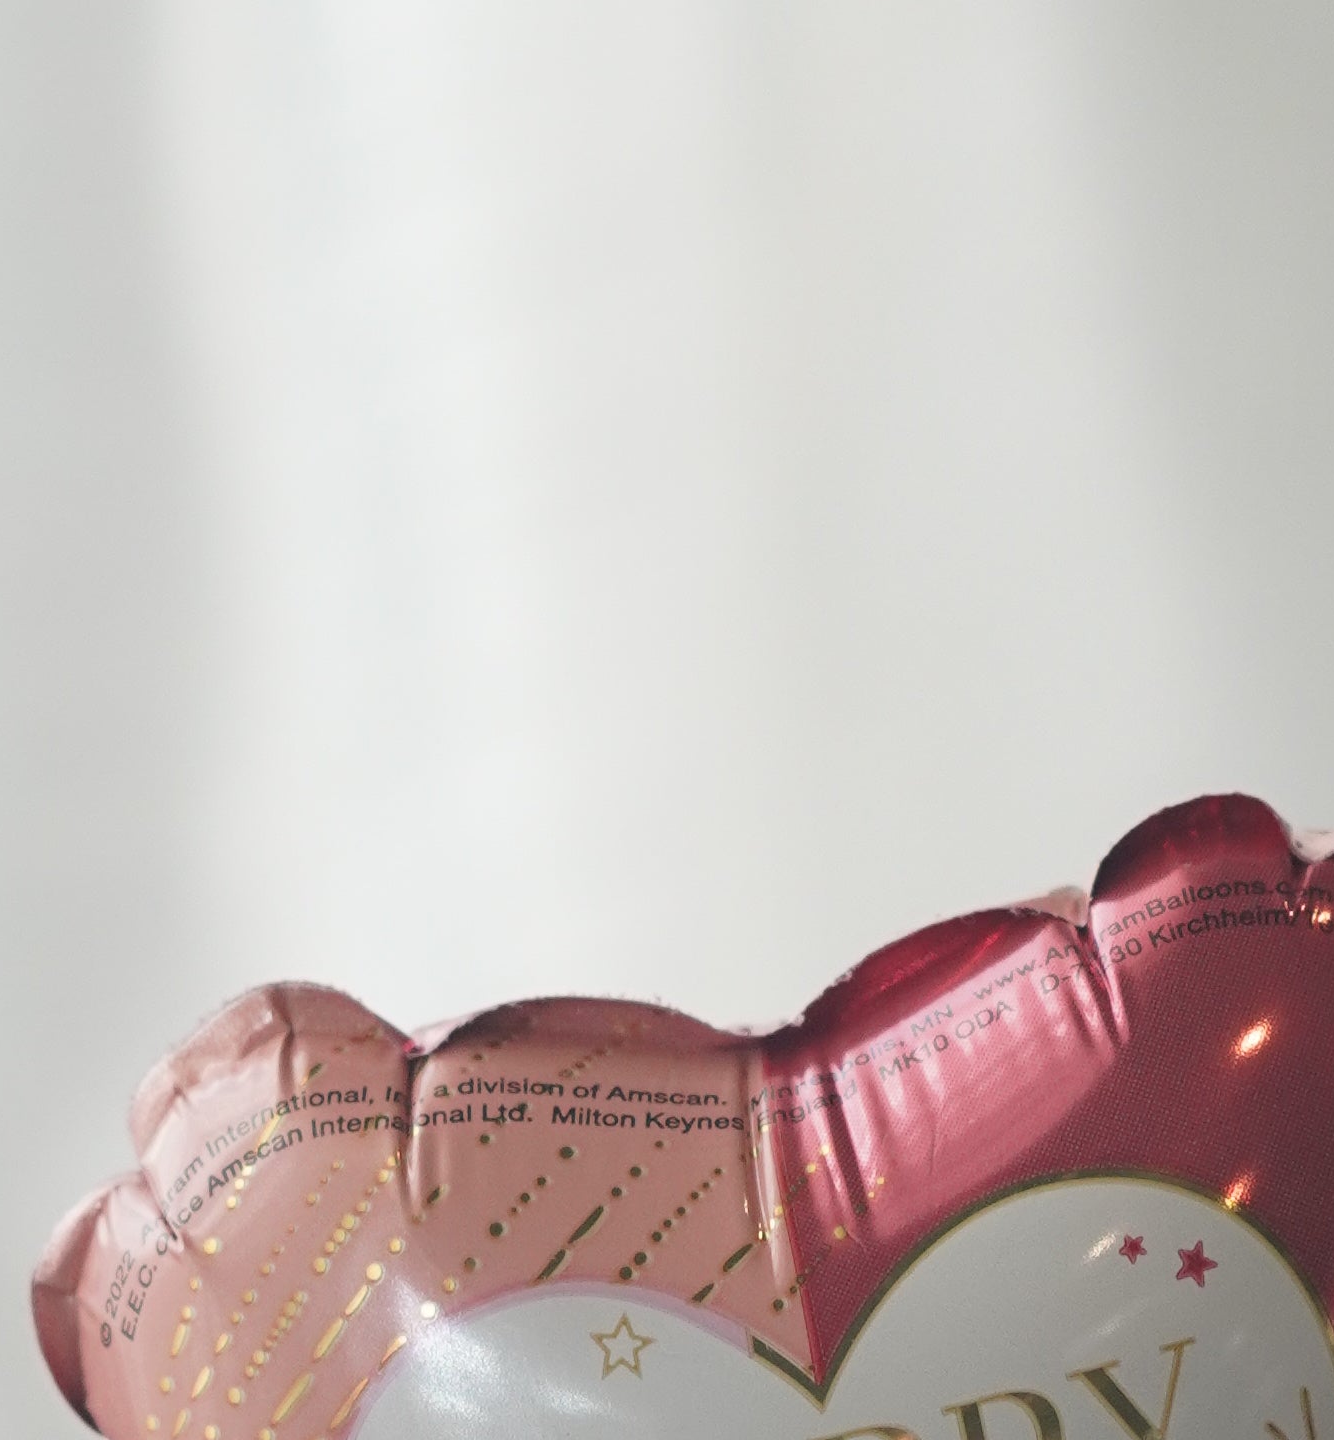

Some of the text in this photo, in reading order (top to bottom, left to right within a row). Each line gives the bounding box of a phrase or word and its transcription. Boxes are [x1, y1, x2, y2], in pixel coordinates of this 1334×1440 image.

[105, 1250, 136, 1321] 2022
[205, 1085, 375, 1158] International,
[434, 1083, 451, 1098] a
[458, 1077, 564, 1097] division
[573, 1082, 602, 1100] of
[606, 1086, 728, 1107] Amscan.
[910, 1003, 955, 1038] MN
[121, 1264, 158, 1342] E.E.C.
[155, 1191, 204, 1257] Oice
[206, 1126, 304, 1198] Amscan
[311, 1103, 472, 1139] Internaonal
[482, 1102, 533, 1123] Ltd.
[551, 1106, 636, 1129] Milton
[877, 1033, 949, 1082] MK10
